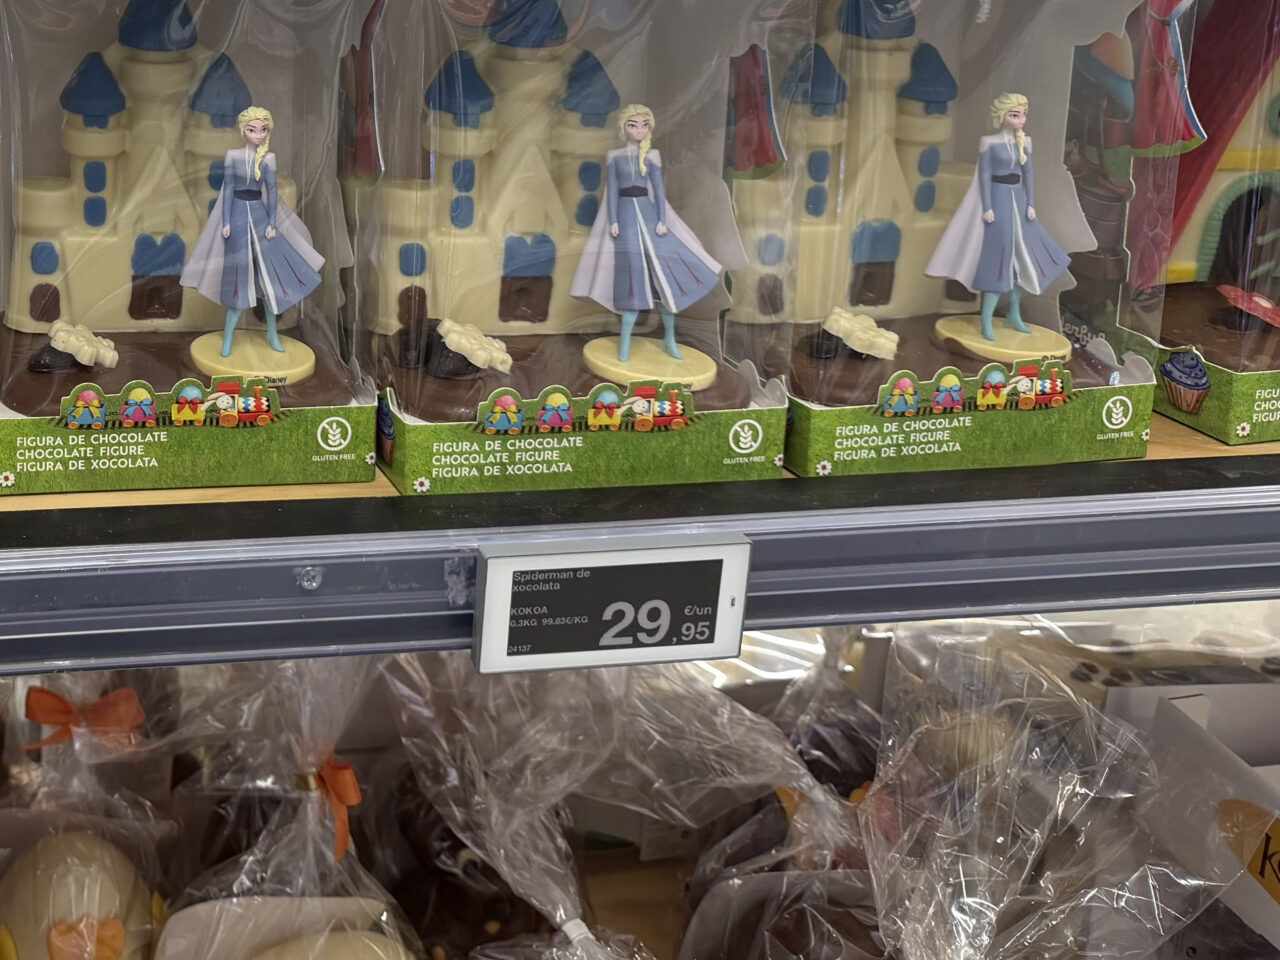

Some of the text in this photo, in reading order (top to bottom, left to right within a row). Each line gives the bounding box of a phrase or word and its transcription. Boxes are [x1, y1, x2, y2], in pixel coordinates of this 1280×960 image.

[1256, 388, 1280, 400] FIGU
[836, 416, 972, 436] FIGURA DE CHOCOLATE
[16, 432, 167, 447] FIGURA DE CHOCOLATE
[834, 430, 950, 448] CHOCOLATE FIGURE
[1097, 430, 1134, 440] GLUTEN FREE
[433, 437, 583, 452] FIGURA DE CHOCOLATE
[834, 442, 961, 461] FIGURA DE XOCOLATA
[16, 446, 144, 460] CHOCOLATE FIGURE
[312, 454, 338, 462] GLUTEN
[432, 450, 559, 465] CHOCOLATE FIGURE
[16, 457, 158, 472] FIGURA DE XOCOLATA
[432, 462, 572, 478] FIGURA DE XOCOLATA
[513, 569, 590, 581] Spiderman de
[512, 581, 560, 592] xocolata
[511, 606, 548, 615] KOKOA
[684, 605, 712, 615] €/un
